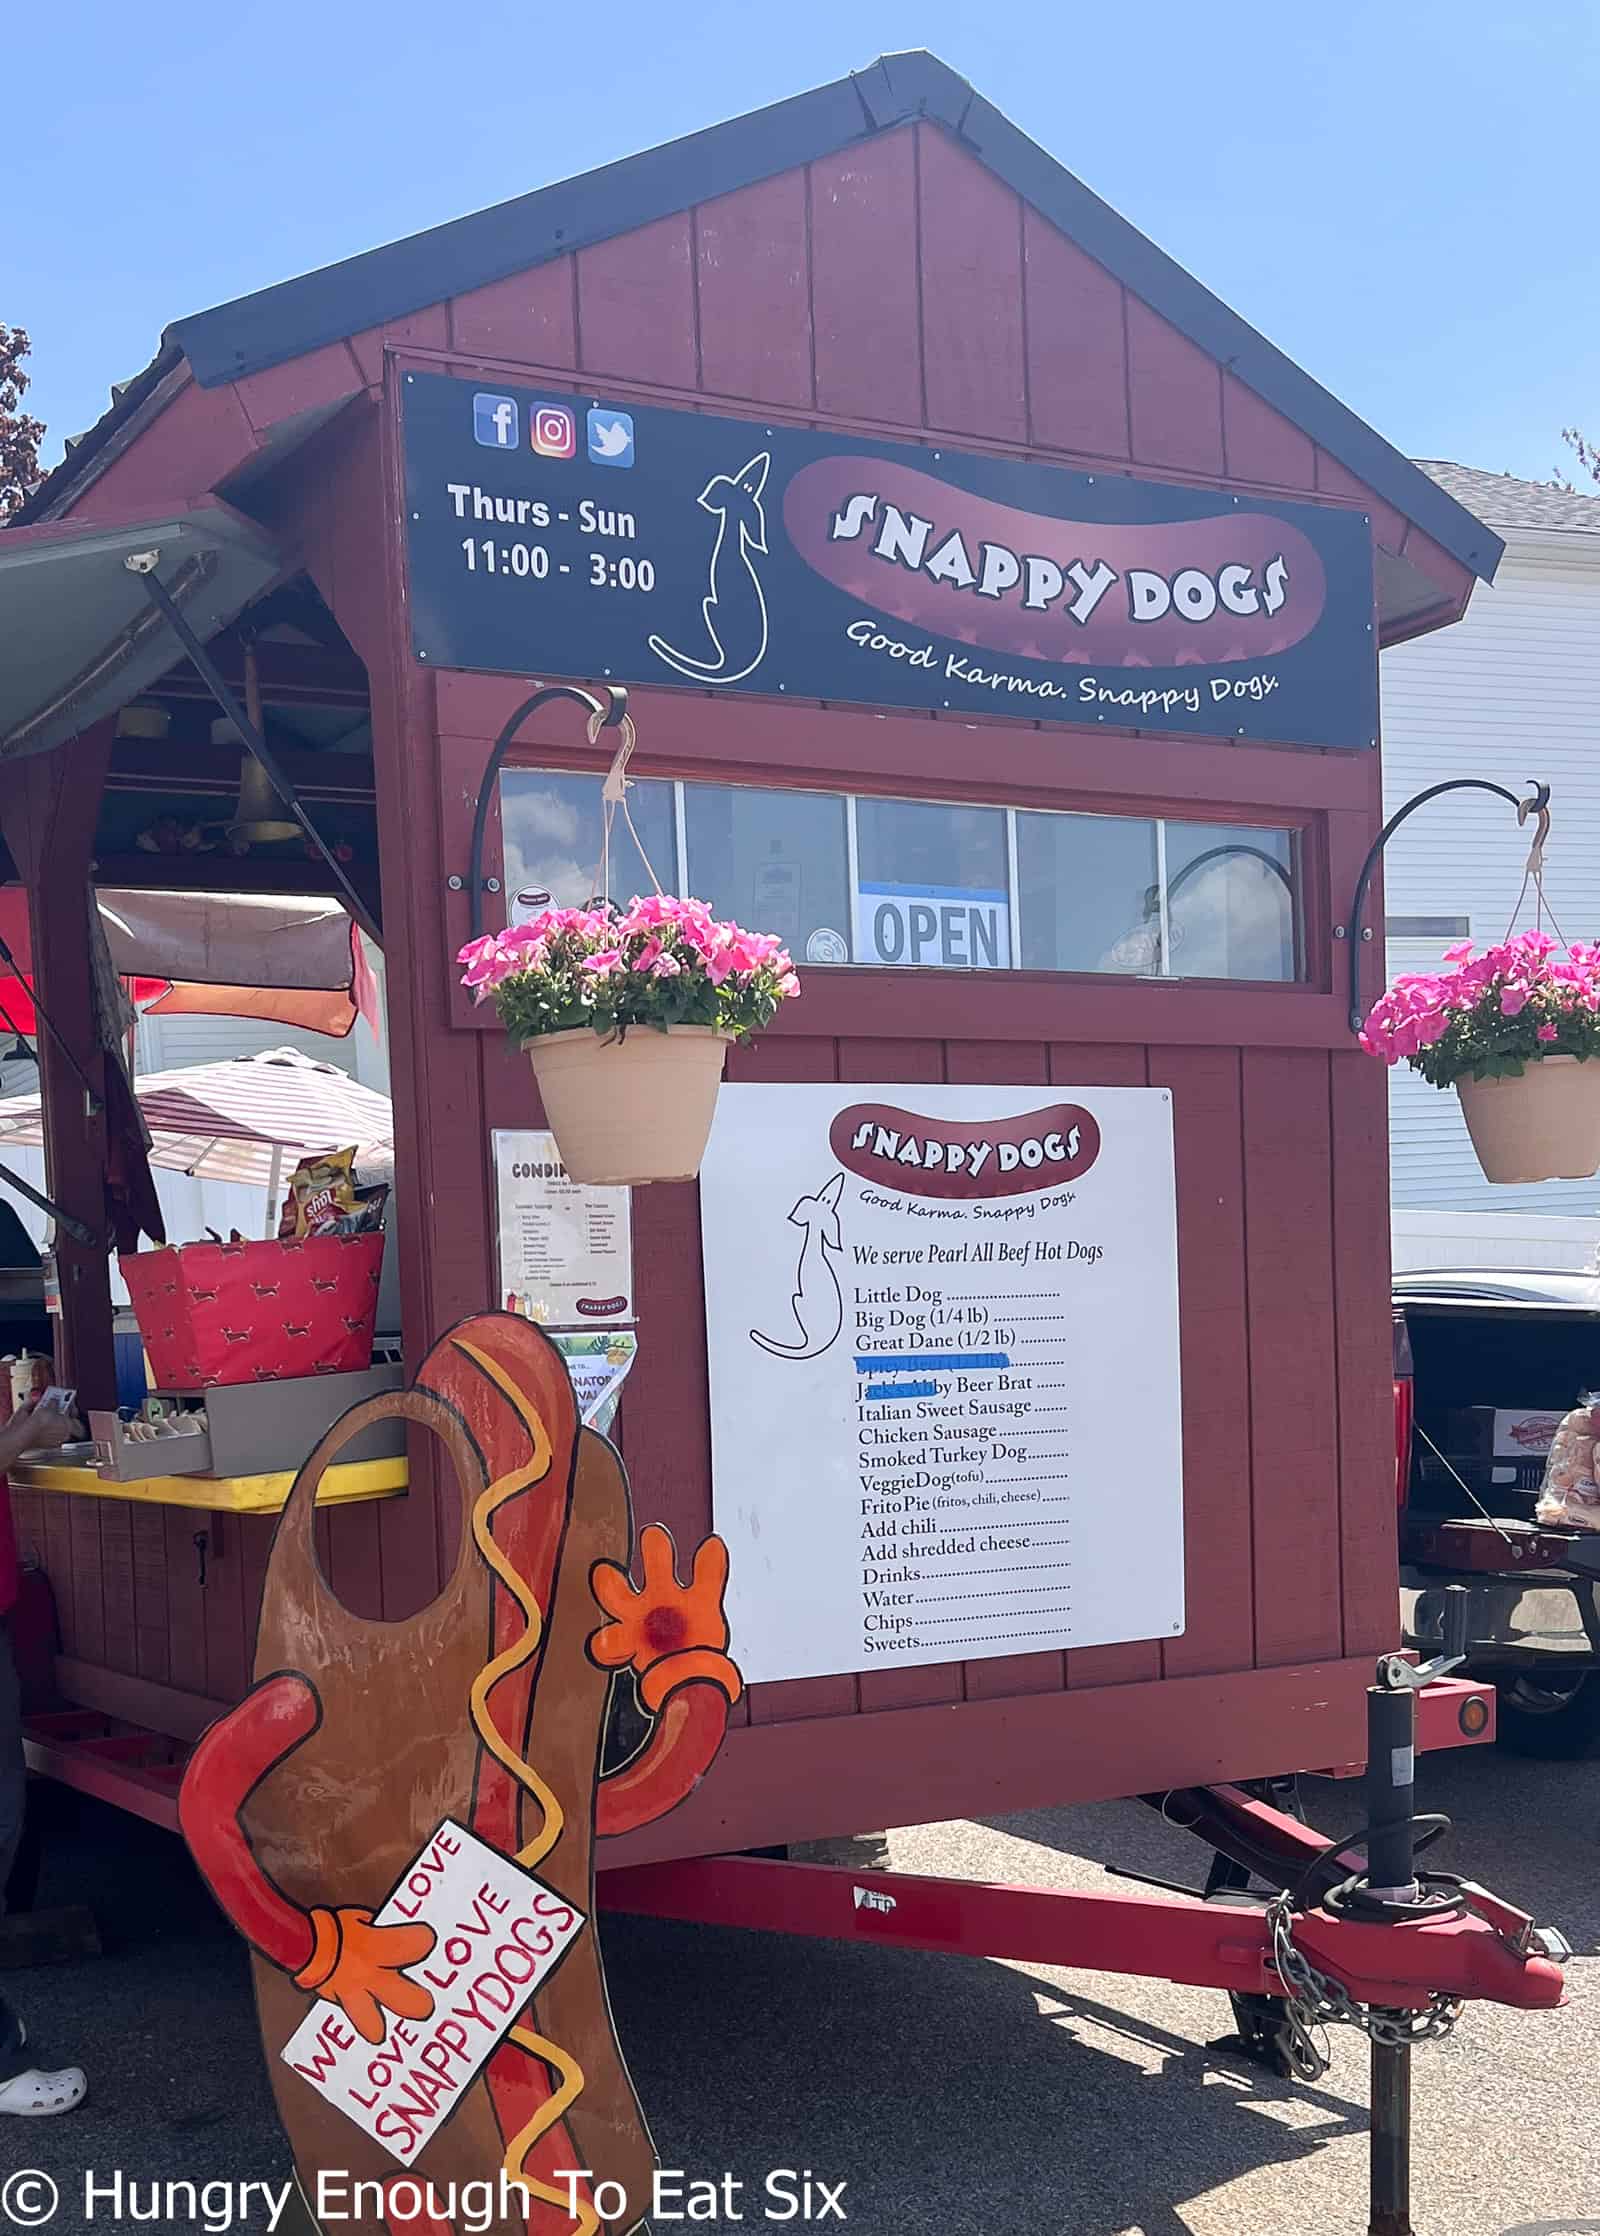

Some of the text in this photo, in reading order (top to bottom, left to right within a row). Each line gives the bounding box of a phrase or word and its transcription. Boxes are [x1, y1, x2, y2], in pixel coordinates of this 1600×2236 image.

[447, 483, 550, 527] Thurs
[579, 500, 635, 538] Sun
[462, 538, 549, 579] 11:00
[590, 553, 655, 591] 3:00
[833, 495, 1289, 624] SNAPPY DOGS
[846, 620, 937, 668] Good
[945, 653, 1067, 699] Karma.
[1079, 678, 1200, 712] Snappy
[873, 903, 999, 968] OPEN
[852, 1121, 1081, 1178] SNAPPY DOGS
[859, 1190, 903, 1212] Good
[907, 1202, 968, 1220] Karma.
[973, 1204, 1035, 1221] Snappy
[852, 1241, 1104, 1267] We serve Pearl All Beef Hot Dogs
[854, 1285, 943, 1306] Little Dog
[855, 1306, 990, 1332] Big Dog (1/4 lb)
[855, 1328, 1017, 1352] Great Dane (1/2 lb)
[957, 1376, 995, 1393] Beer
[998, 1374, 1033, 1391] Brat
[857, 1398, 1032, 1422] Italian Sweet Sausage
[858, 1424, 998, 1445] Chicken Sausage
[859, 1443, 1028, 1469] Smoked Turkey Dog
[860, 1499, 901, 1516] Frito
[903, 1496, 930, 1513] Pie
[860, 1518, 937, 1539] Add chili
[861, 1534, 1031, 1562] Add shredded cheese
[863, 1566, 922, 1585] Drinks
[863, 1590, 915, 1608] Water
[863, 1614, 913, 1634] Chips
[863, 1635, 921, 1653] Sweets
[294, 1830, 461, 2083] WE LOVE
[348, 1883, 511, 2109] LOVE LOVE
